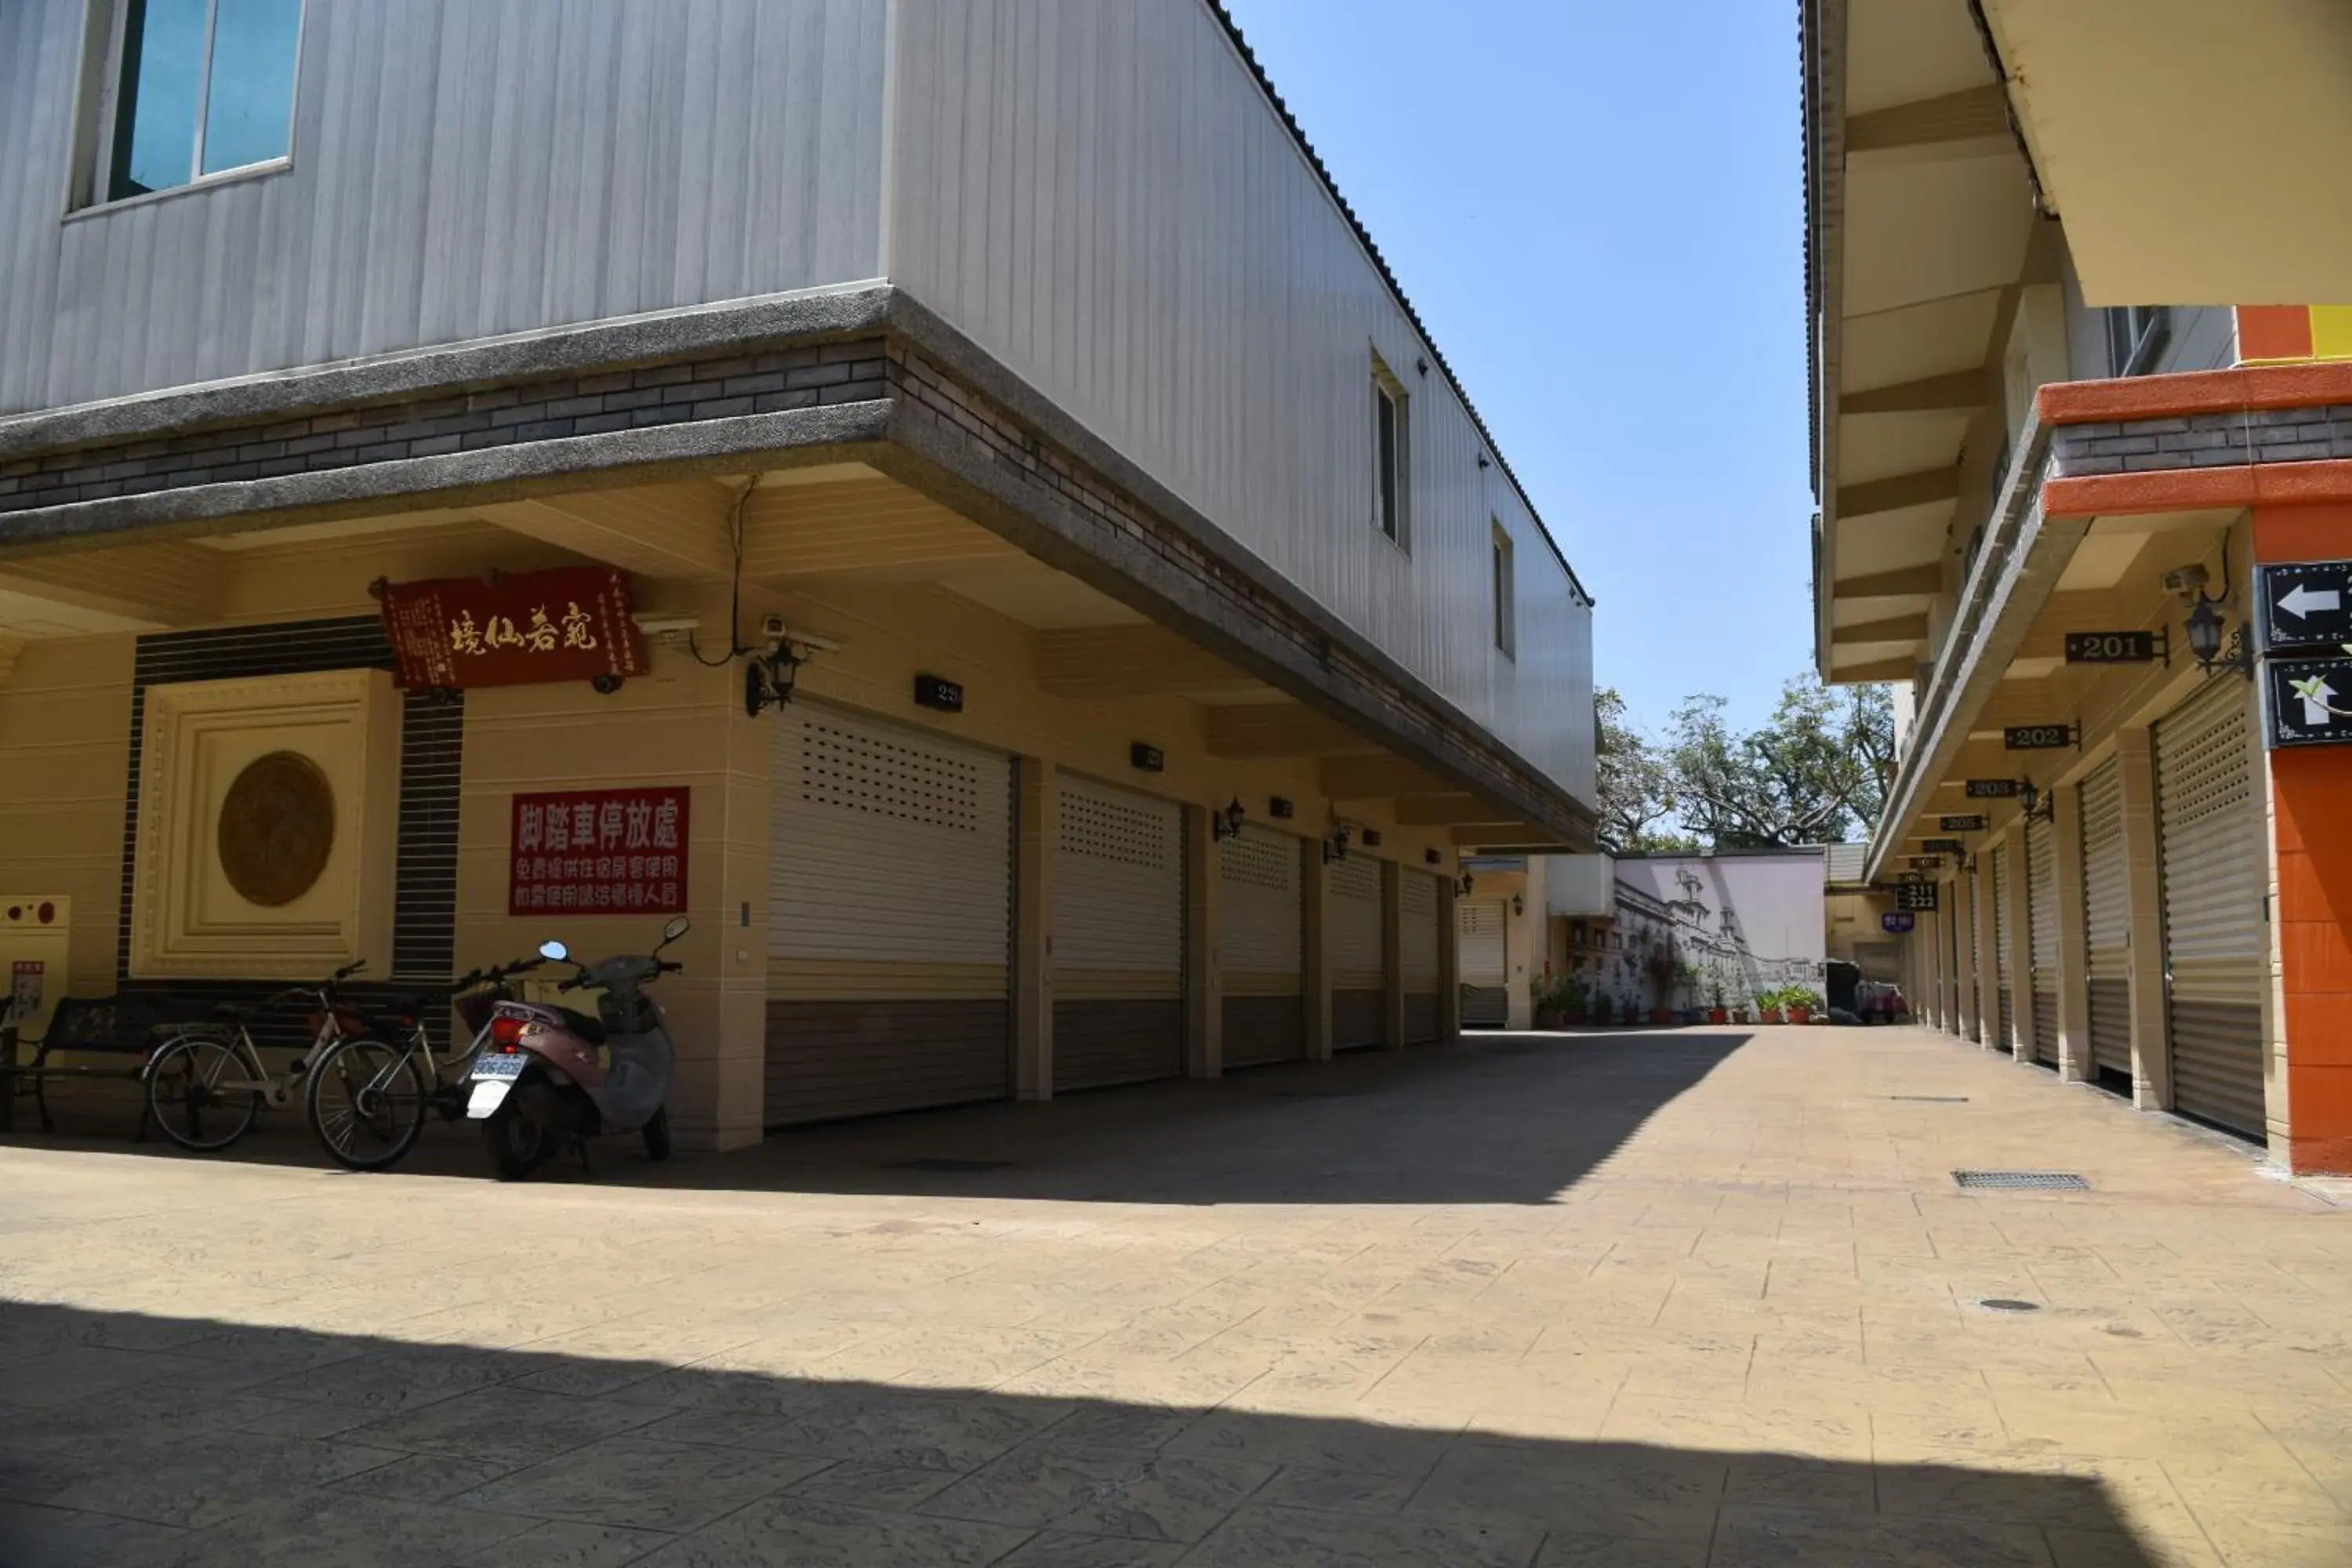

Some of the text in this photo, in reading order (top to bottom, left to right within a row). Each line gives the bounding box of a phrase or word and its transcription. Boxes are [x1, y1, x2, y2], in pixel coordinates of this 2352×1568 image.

[2083, 636, 2138, 657] 201
[2016, 728, 2060, 746] 202
[1908, 884, 1933, 895] 211
[1909, 896, 1935, 908] 222
